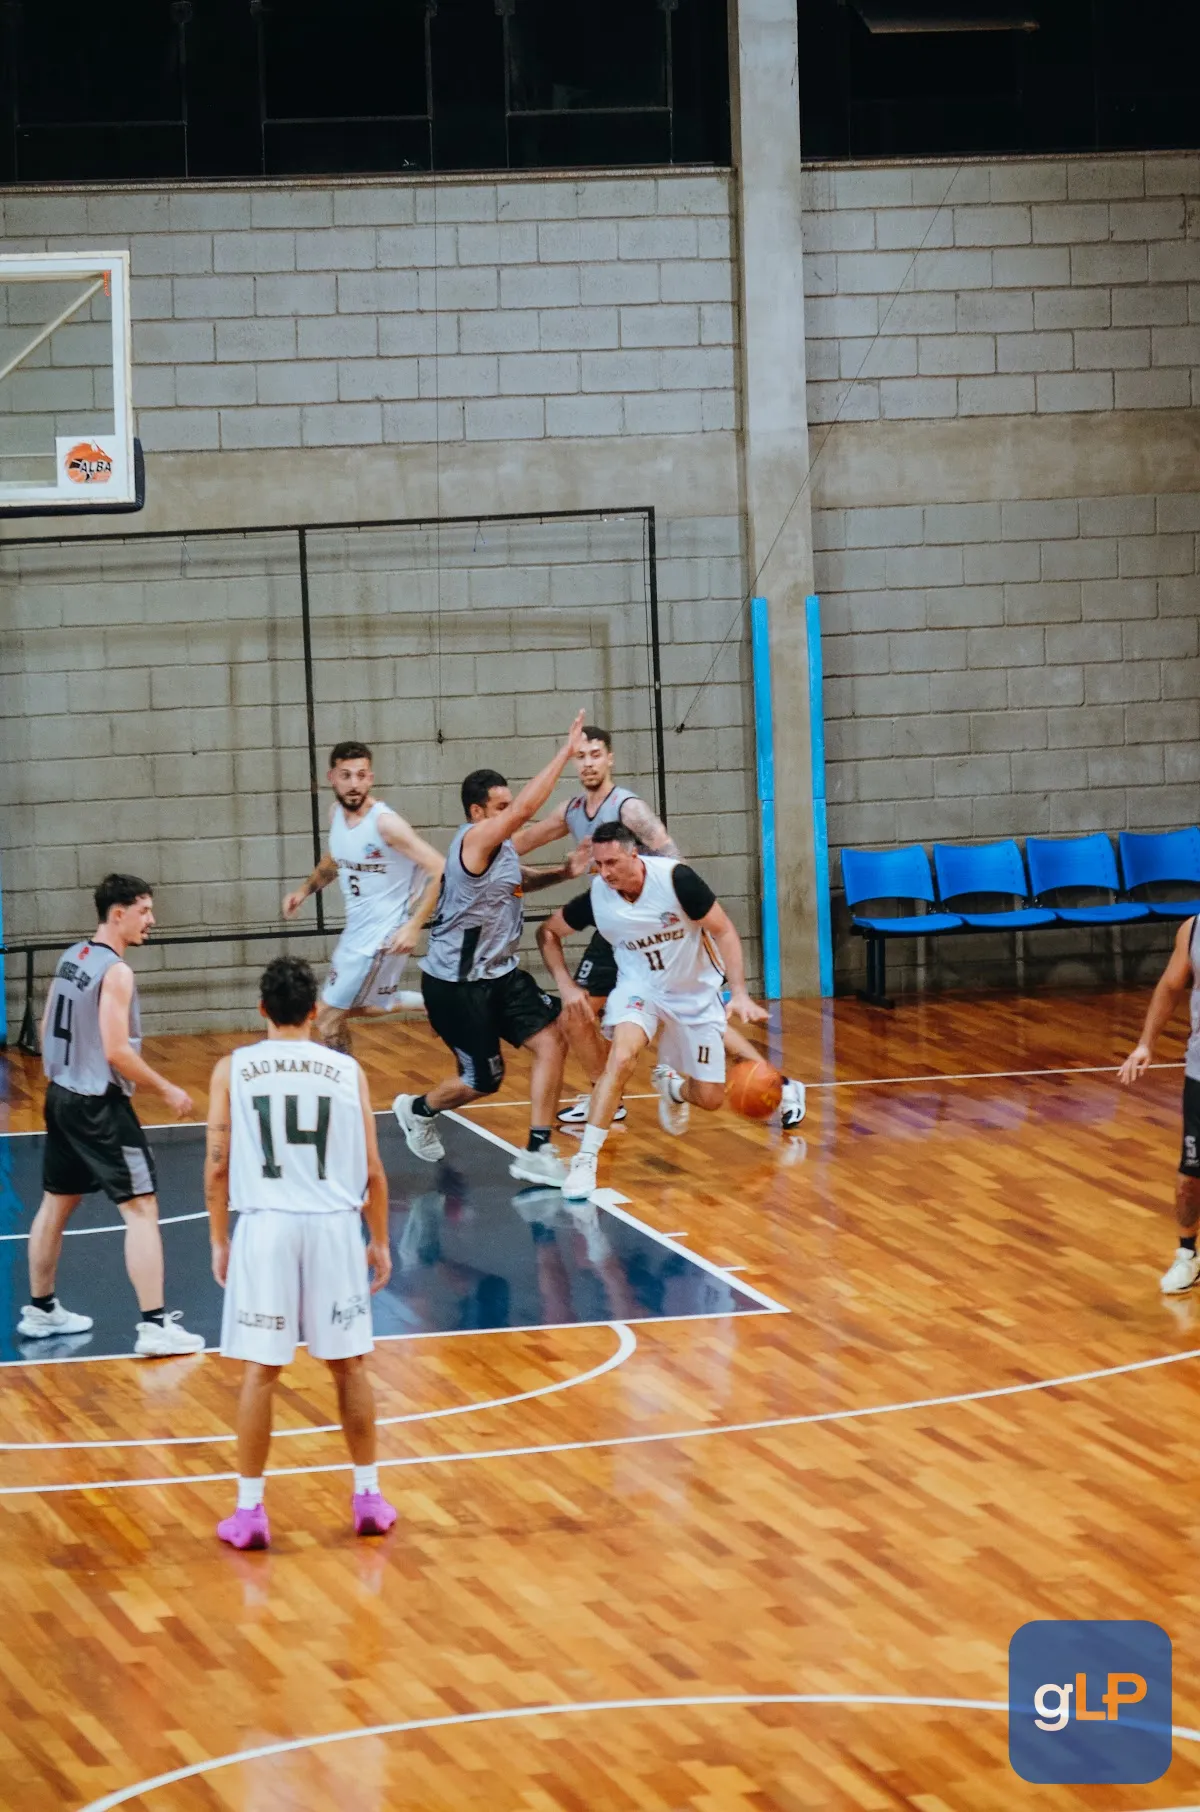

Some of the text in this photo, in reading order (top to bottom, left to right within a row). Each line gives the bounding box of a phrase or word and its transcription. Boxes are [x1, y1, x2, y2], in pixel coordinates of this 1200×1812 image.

[636, 928, 685, 949] MANUEL
[645, 950, 665, 971] 11
[53, 994, 73, 1067] 4
[697, 1045, 709, 1064] 11
[274, 1059, 342, 1084] MANUEL
[251, 1095, 332, 1180] 14
